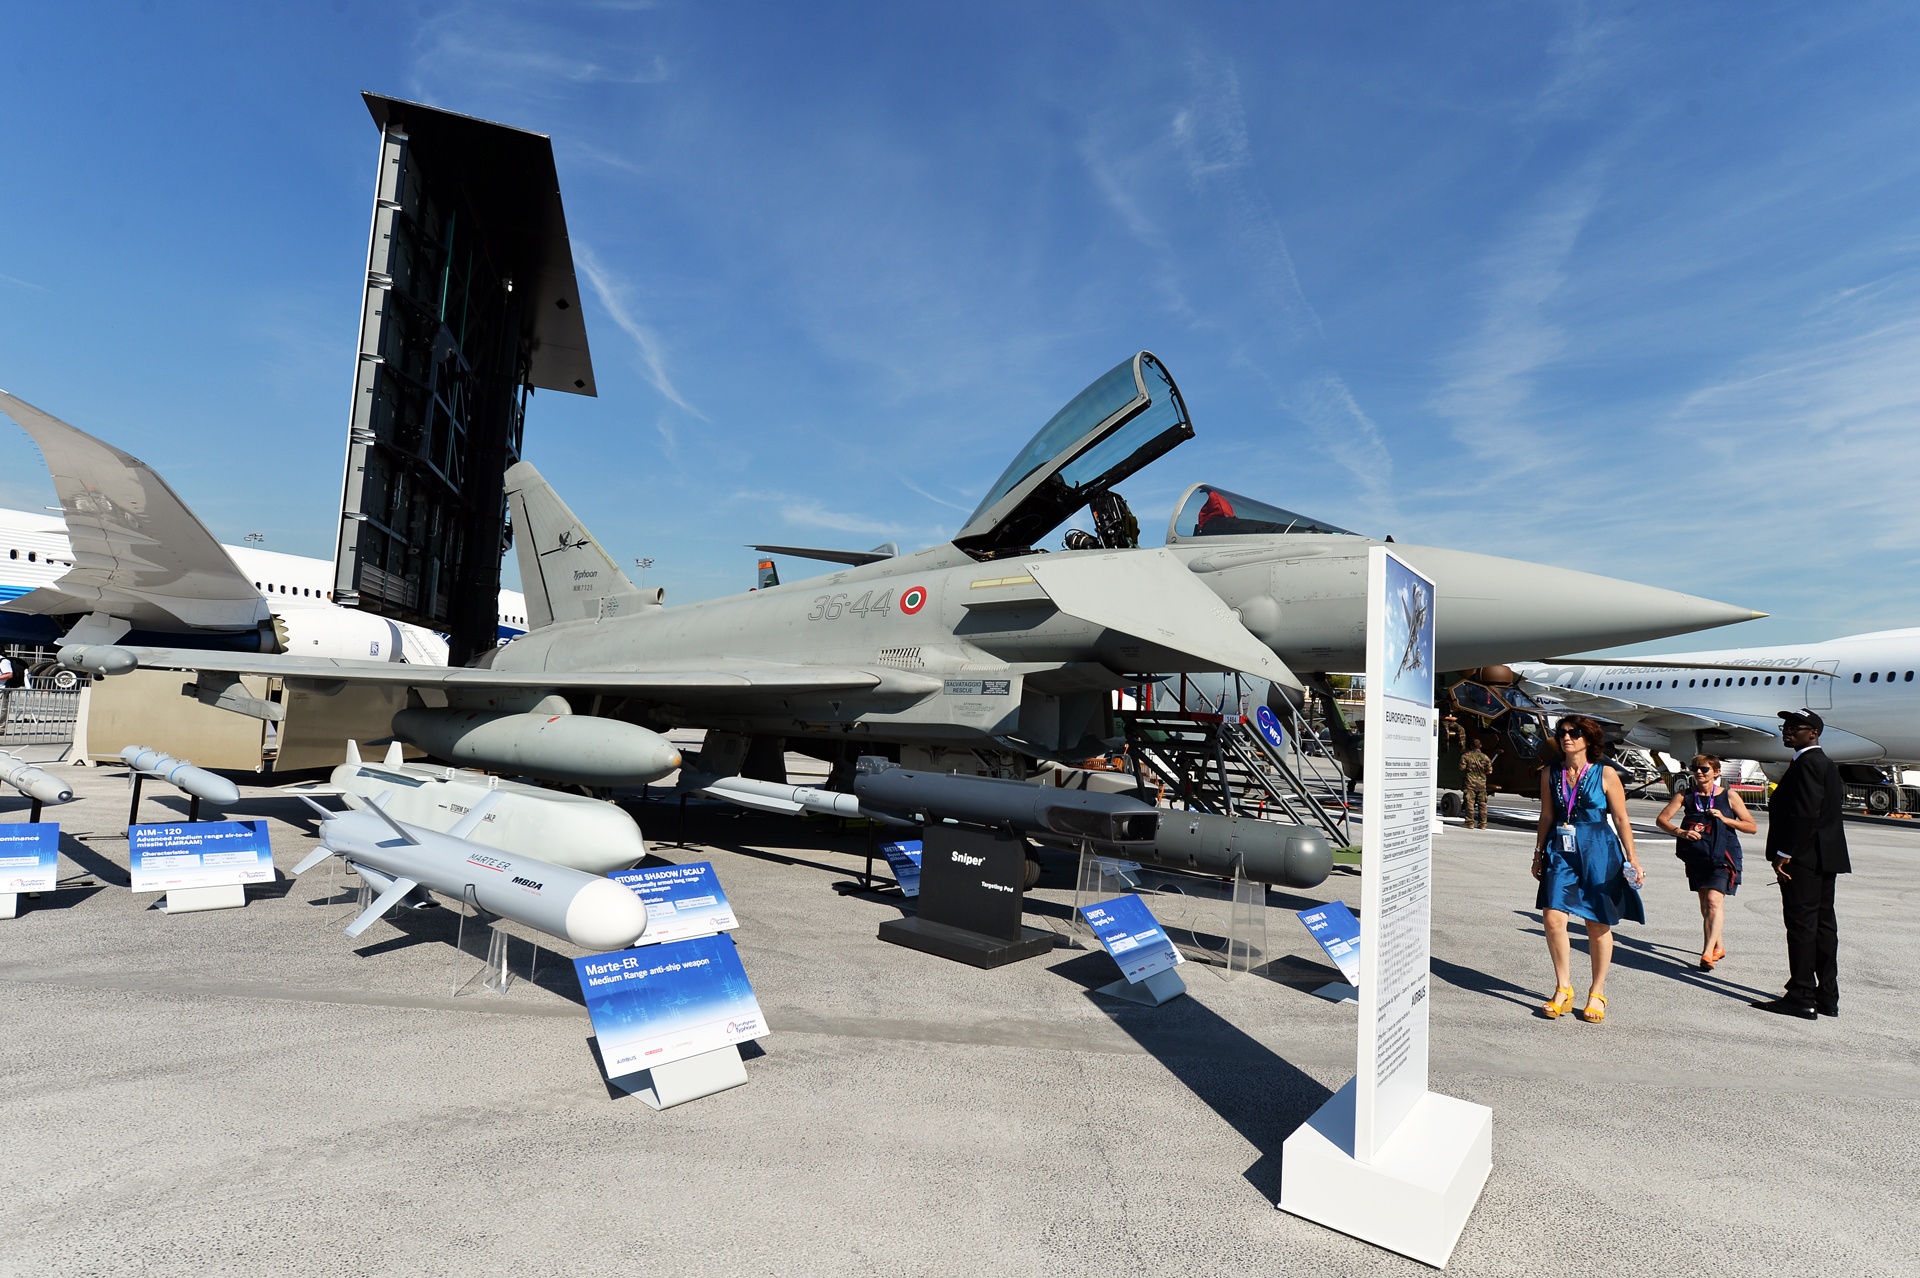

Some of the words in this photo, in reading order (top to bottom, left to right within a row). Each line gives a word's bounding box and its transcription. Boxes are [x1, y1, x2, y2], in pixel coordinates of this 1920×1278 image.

[574, 570, 598, 580] Typhoon
[1385, 711, 1412, 725] EUROFIGHTER
[484, 813, 496, 821] CALP
[137, 835, 172, 843] Advanced
[165, 839, 203, 847] (AMRAAM)
[468, 853, 498, 867] MARTE
[496, 860, 512, 871] ER
[644, 870, 678, 880] SHADOW
[683, 867, 706, 877] SCALP
[512, 876, 544, 891] MBDA
[981, 881, 1003, 892] Targeting
[1003, 885, 1014, 893] Pod
[585, 957, 639, 976] Marte-ER
[589, 974, 623, 987] Medium
[623, 970, 648, 980] Range
[649, 962, 682, 975] anti-ship
[682, 957, 710, 970] weapon
[735, 1024, 757, 1034] Typhoon
